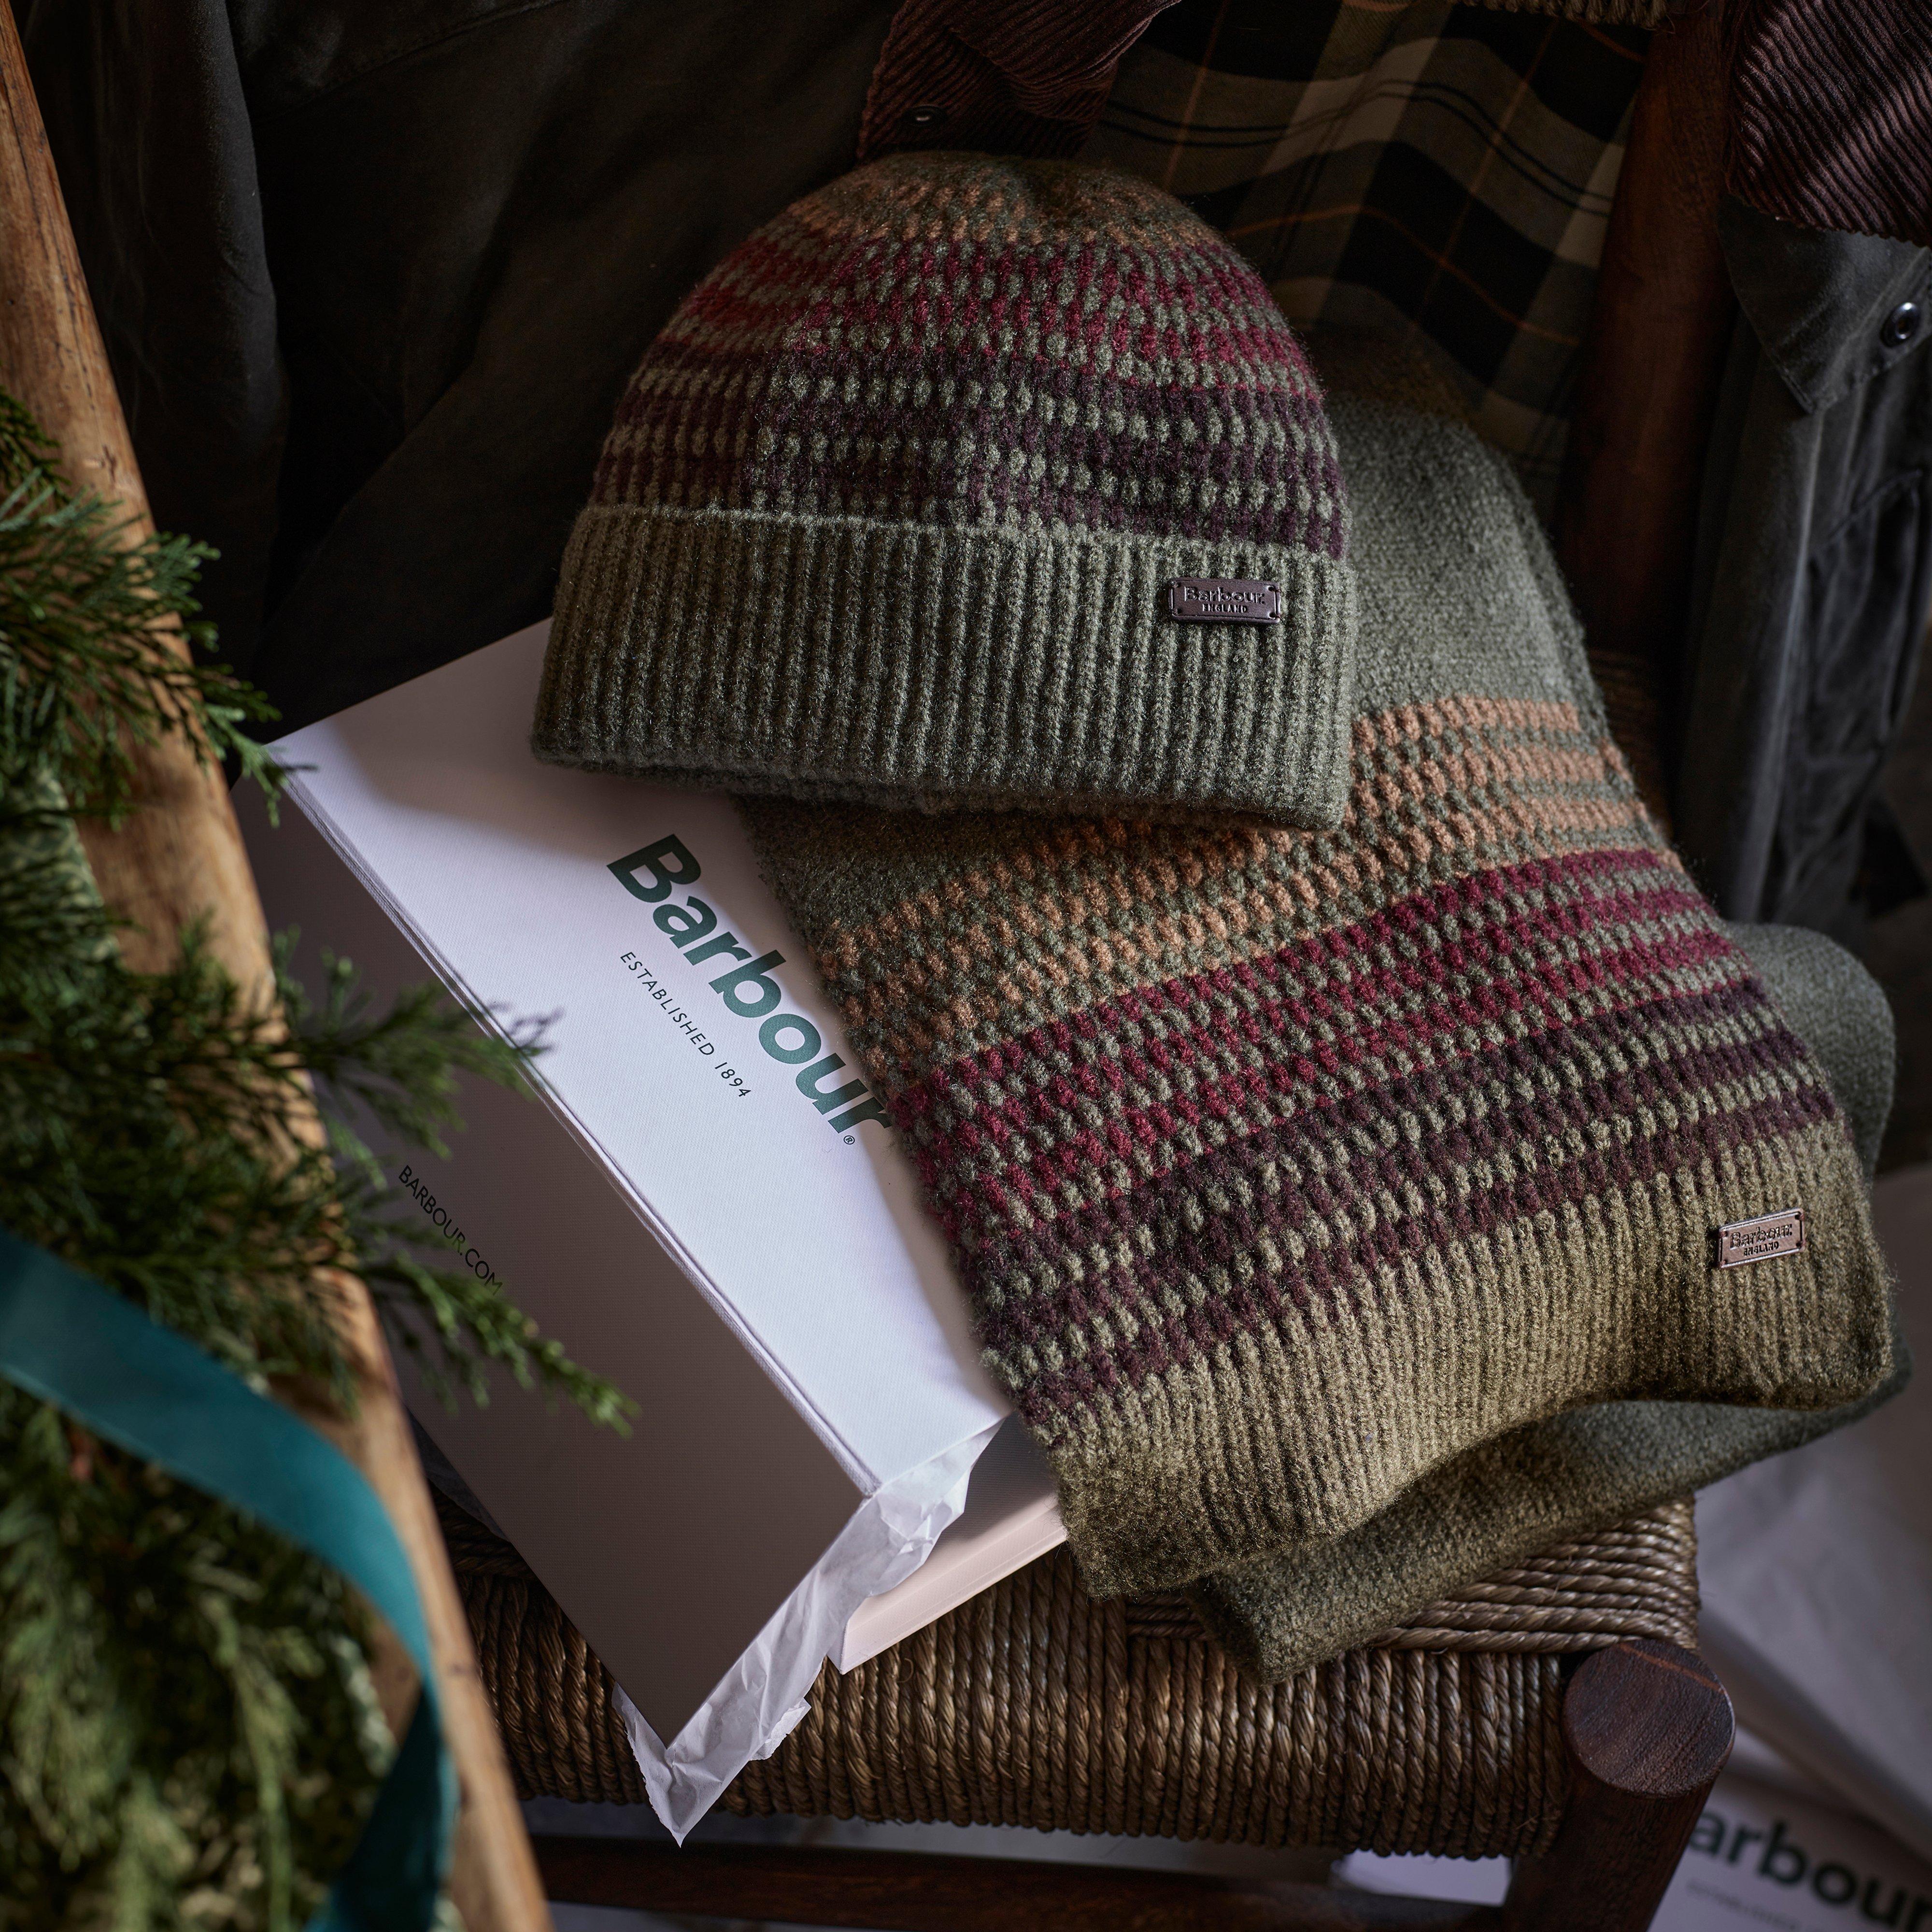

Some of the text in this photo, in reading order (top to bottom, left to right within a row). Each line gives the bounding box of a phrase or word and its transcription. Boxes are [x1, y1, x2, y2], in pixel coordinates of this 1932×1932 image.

[1203, 604, 1248, 613] ENGLAND
[621, 952, 752, 1097] ESTABLISHED 1894
[399, 1165, 503, 1295] BARBOUR.COM
[1690, 1812, 1932, 1932] arbour
